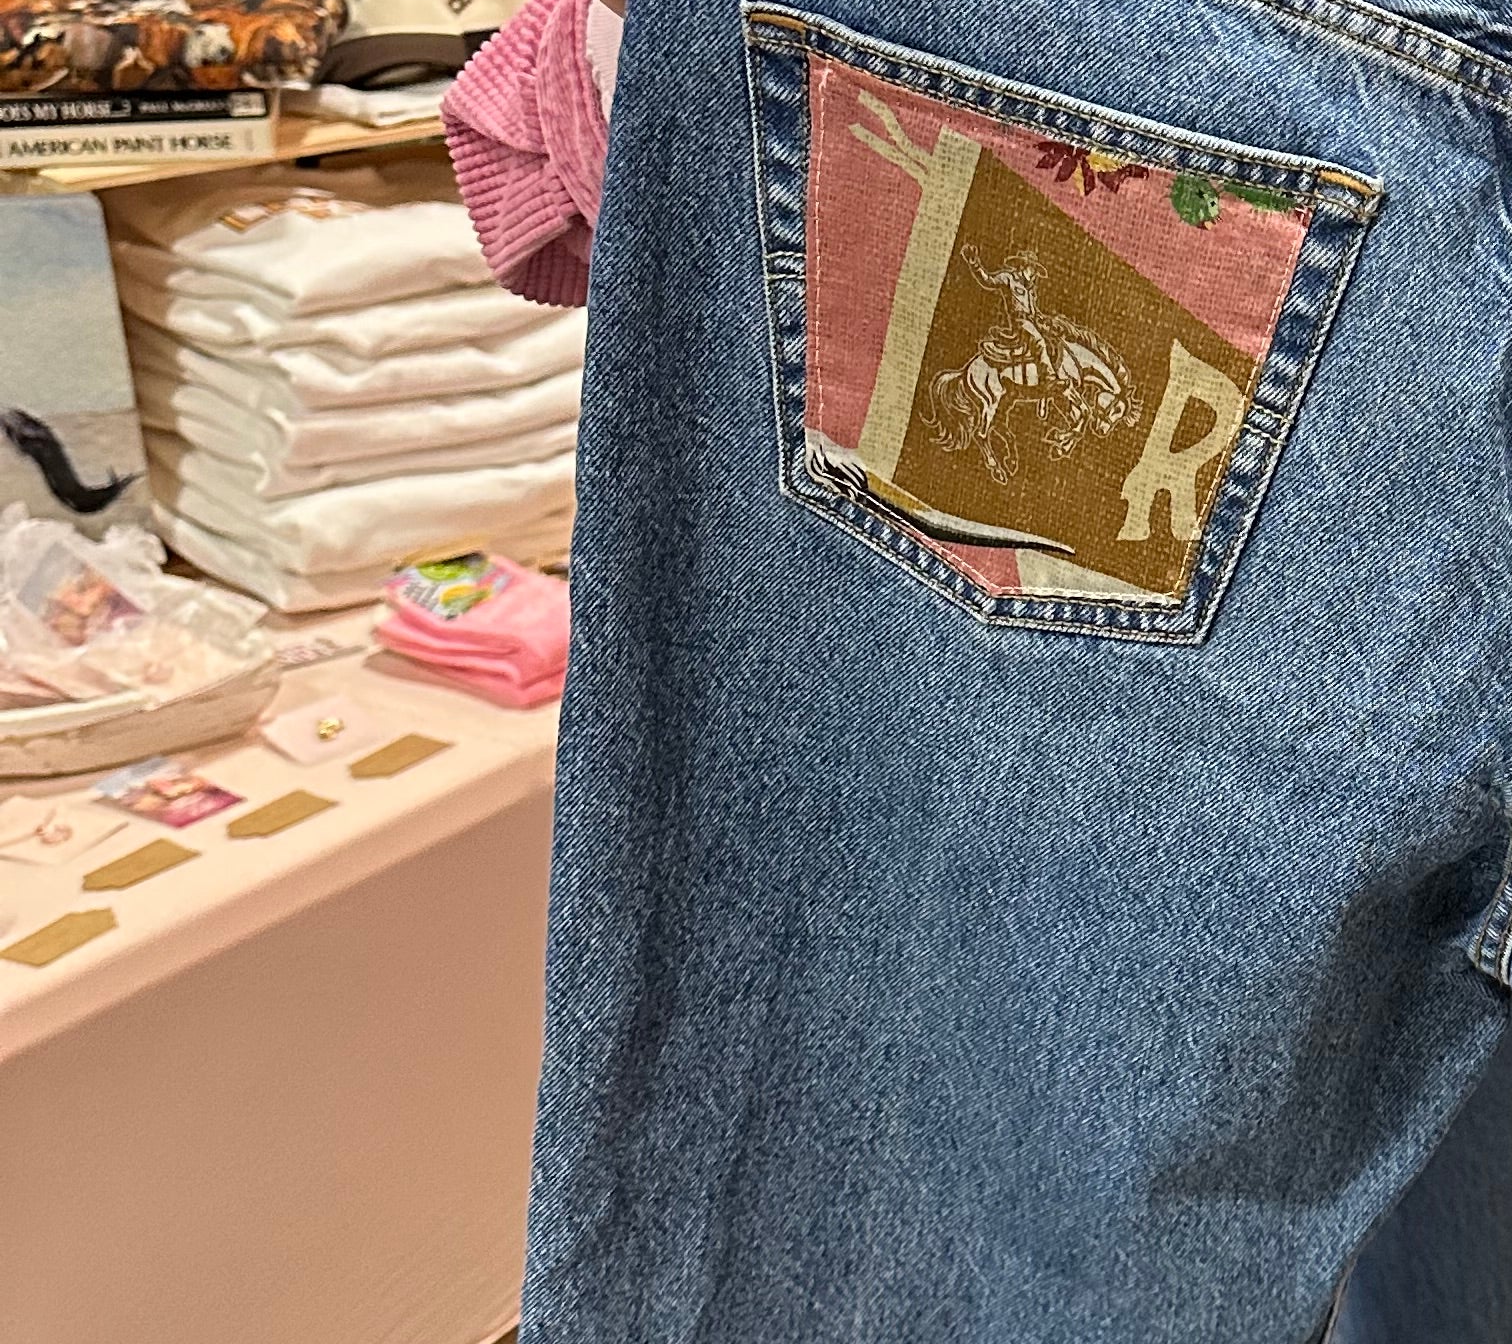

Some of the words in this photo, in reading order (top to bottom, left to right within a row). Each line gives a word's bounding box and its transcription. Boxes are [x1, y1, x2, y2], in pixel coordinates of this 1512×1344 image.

[8, 136, 108, 156] AMERICAN
[112, 134, 164, 153] PAINT
[169, 133, 233, 151] HORSE
